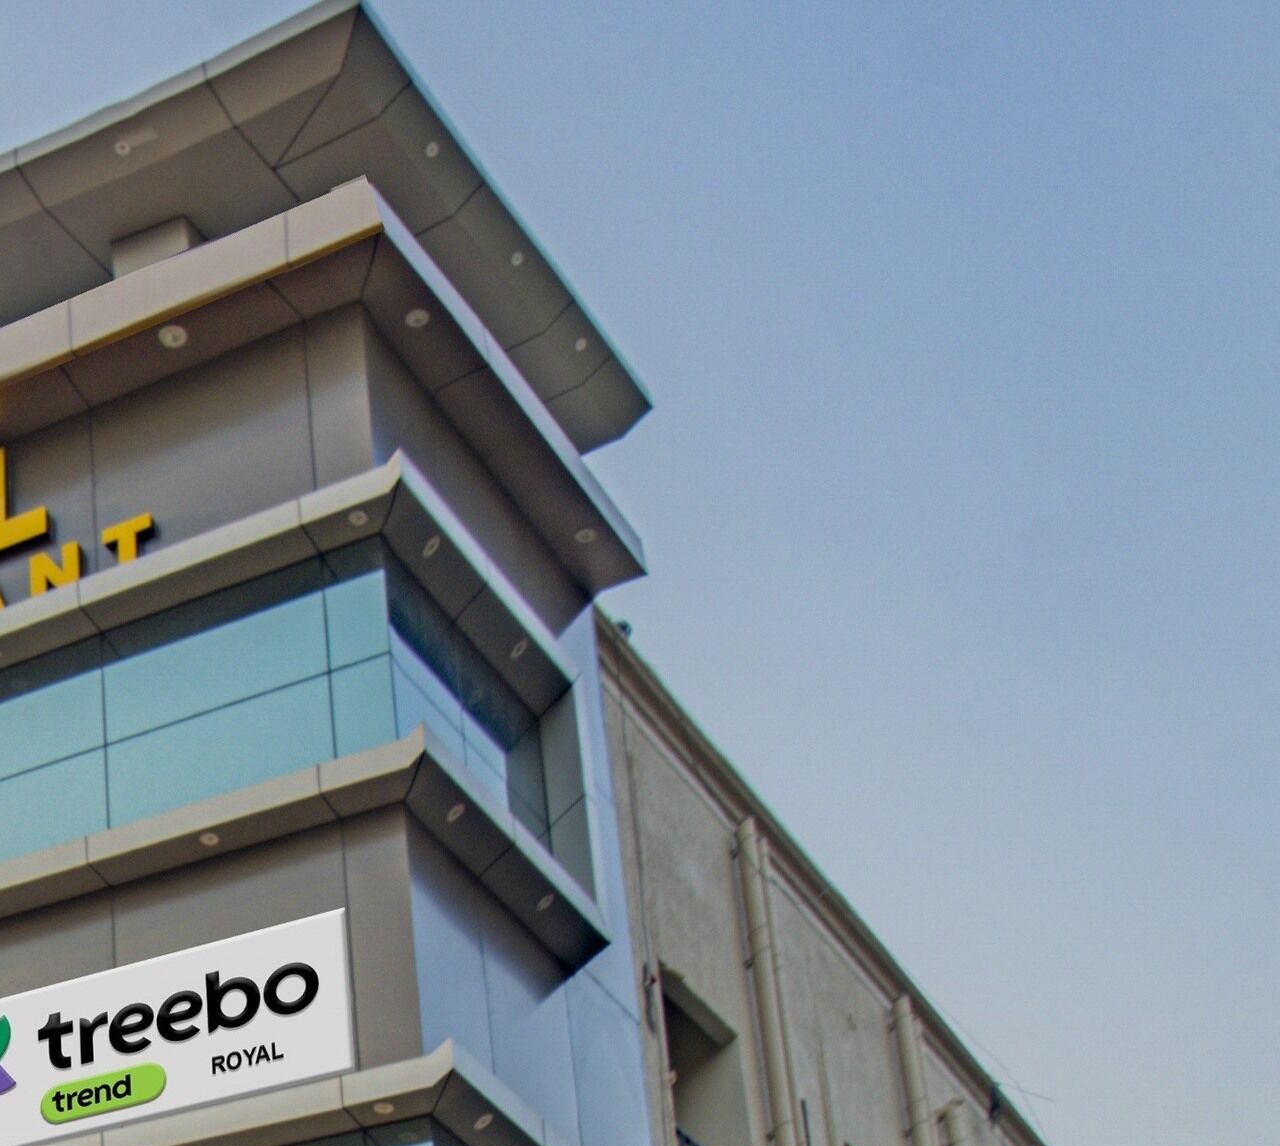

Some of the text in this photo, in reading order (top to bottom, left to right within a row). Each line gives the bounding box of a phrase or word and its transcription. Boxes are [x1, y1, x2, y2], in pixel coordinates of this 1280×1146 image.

[38, 962, 319, 1070] treebo
[211, 1041, 284, 1075] ROYAL
[52, 1074, 132, 1113] trend
